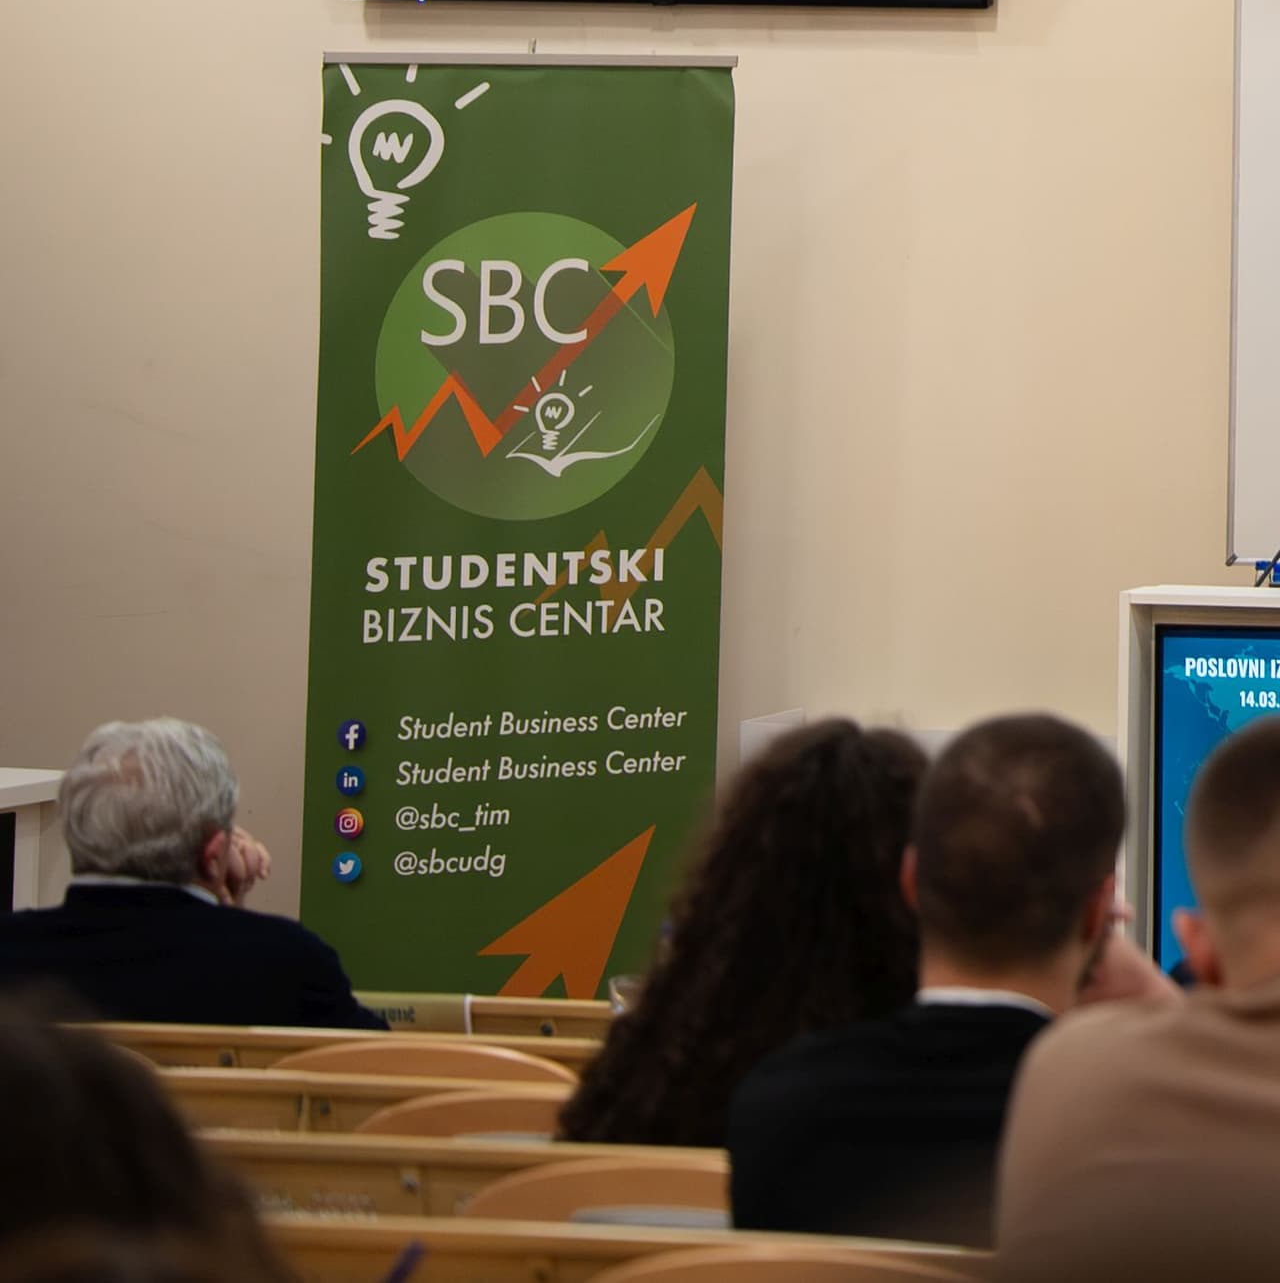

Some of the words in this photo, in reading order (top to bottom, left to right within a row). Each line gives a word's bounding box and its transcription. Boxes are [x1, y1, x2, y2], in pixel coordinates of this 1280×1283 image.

[419, 257, 590, 347] SBC
[364, 547, 666, 594] STUDENTSKI
[362, 603, 495, 644] BIZNIS
[509, 597, 666, 638] CENTAR
[1184, 657, 1266, 679] POSLOVNI
[396, 711, 493, 741] Student
[499, 709, 599, 737] Business
[606, 704, 688, 733] Center
[395, 758, 491, 787] Student
[498, 754, 597, 781] Business
[605, 749, 687, 777] Center
[394, 803, 511, 833] @sbc_tim
[393, 845, 507, 879] @sbcudg
